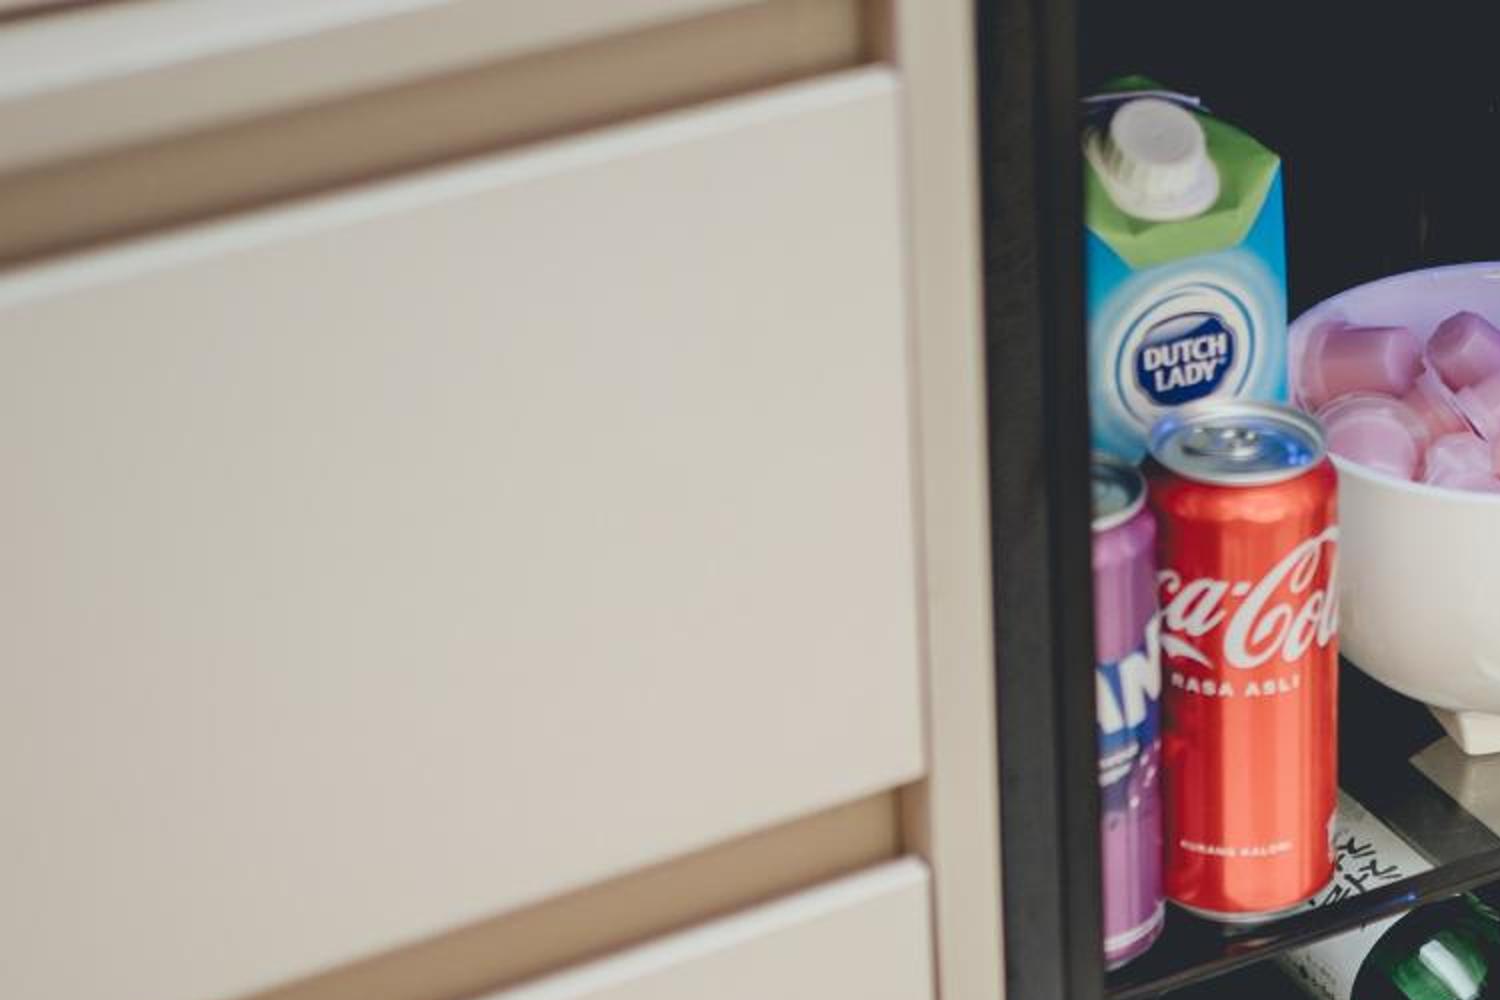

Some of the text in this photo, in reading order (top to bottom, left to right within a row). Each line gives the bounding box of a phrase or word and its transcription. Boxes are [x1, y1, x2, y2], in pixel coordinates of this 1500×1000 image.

[1143, 332, 1228, 372] DUTCH
[1154, 358, 1218, 393] LADY
[1171, 672, 1300, 697] RASA ASLI
